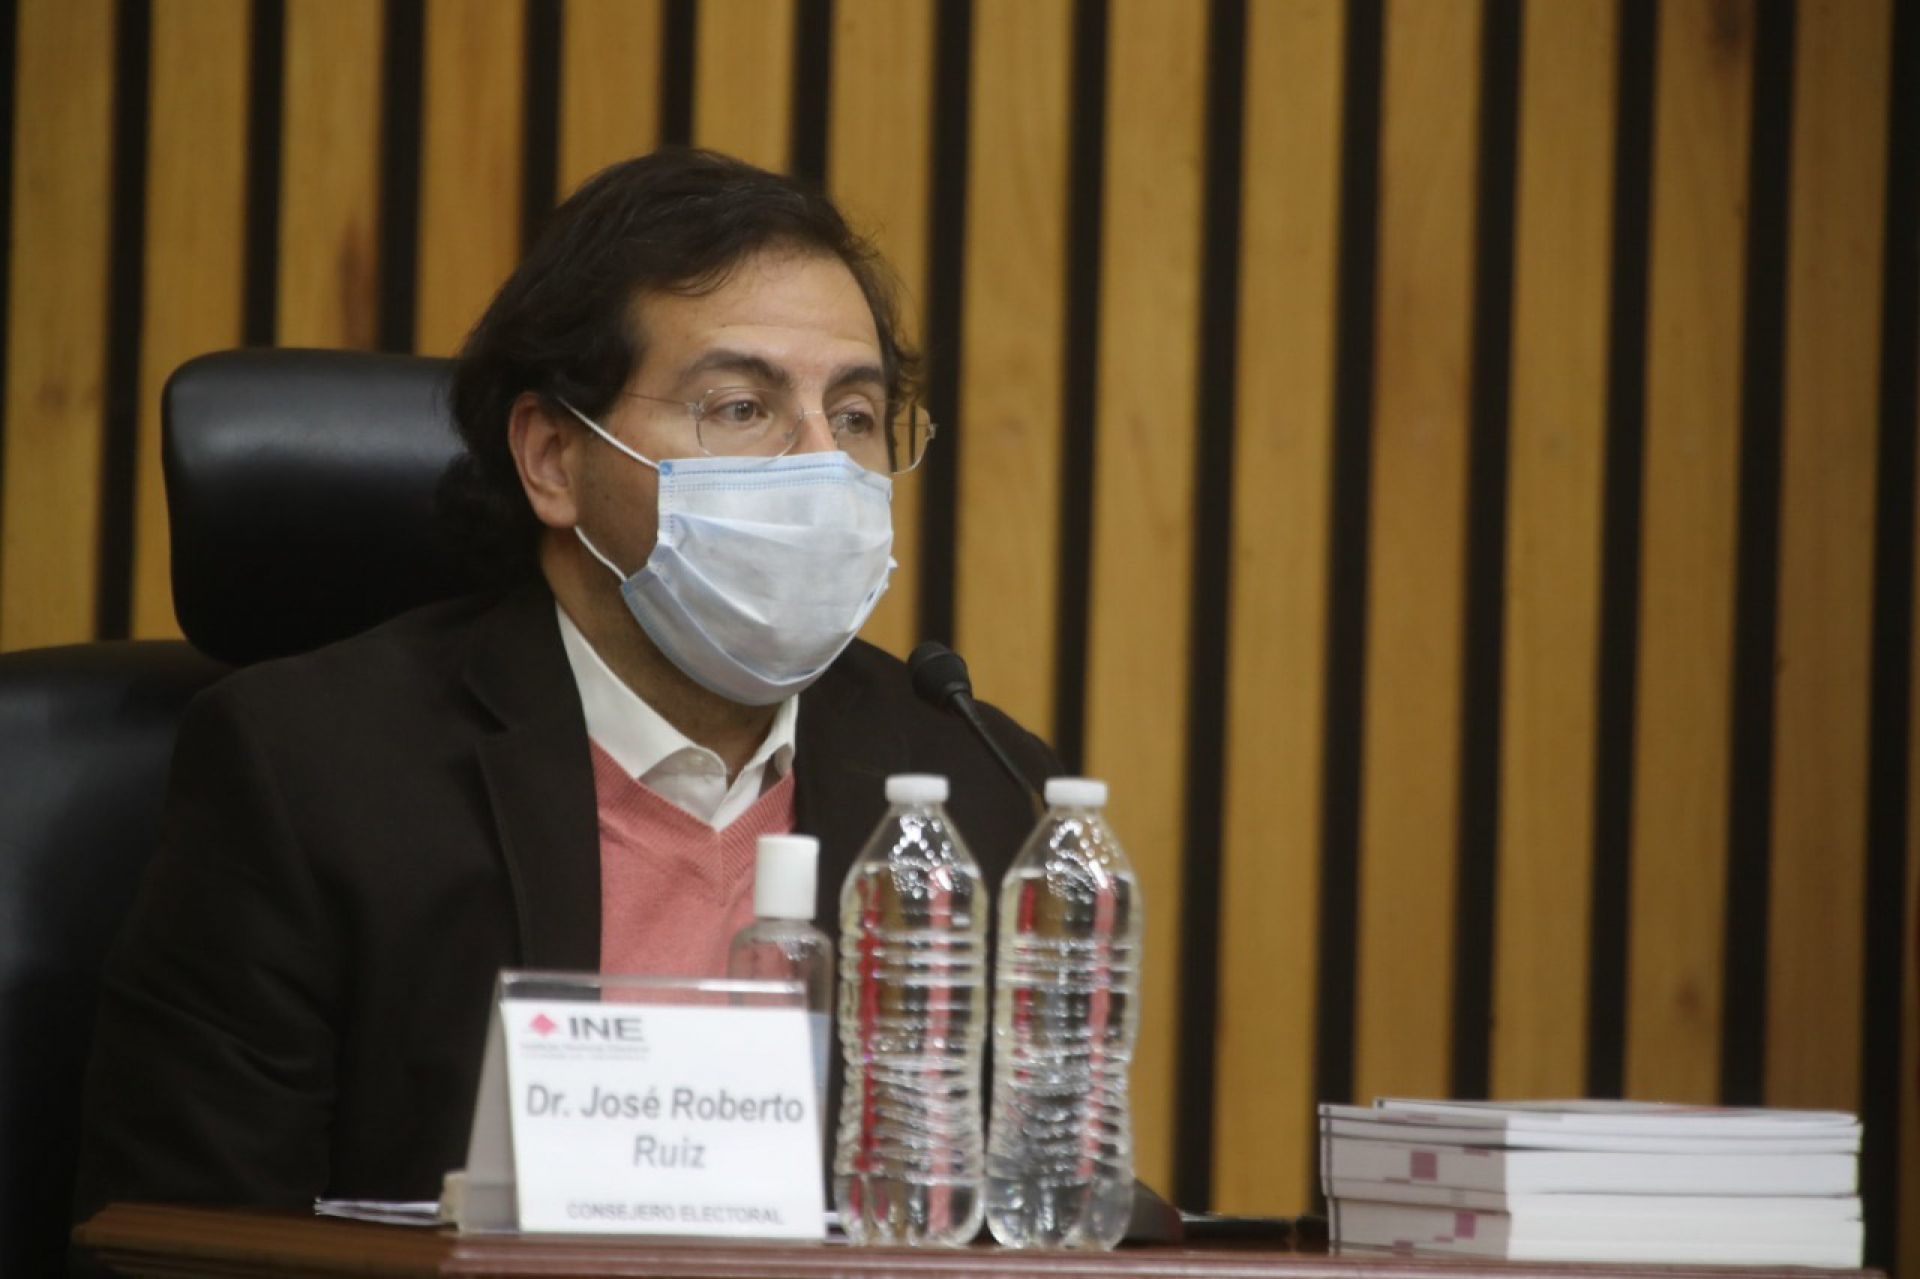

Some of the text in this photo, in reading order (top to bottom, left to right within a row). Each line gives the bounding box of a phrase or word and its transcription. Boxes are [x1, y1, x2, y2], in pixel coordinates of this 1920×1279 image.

[568, 1017, 644, 1042] INE
[526, 1083, 805, 1122] Dr. José Roberto
[633, 1135, 705, 1169] Ruiz
[566, 1202, 784, 1224] CONSEJERO ELECTORAL
